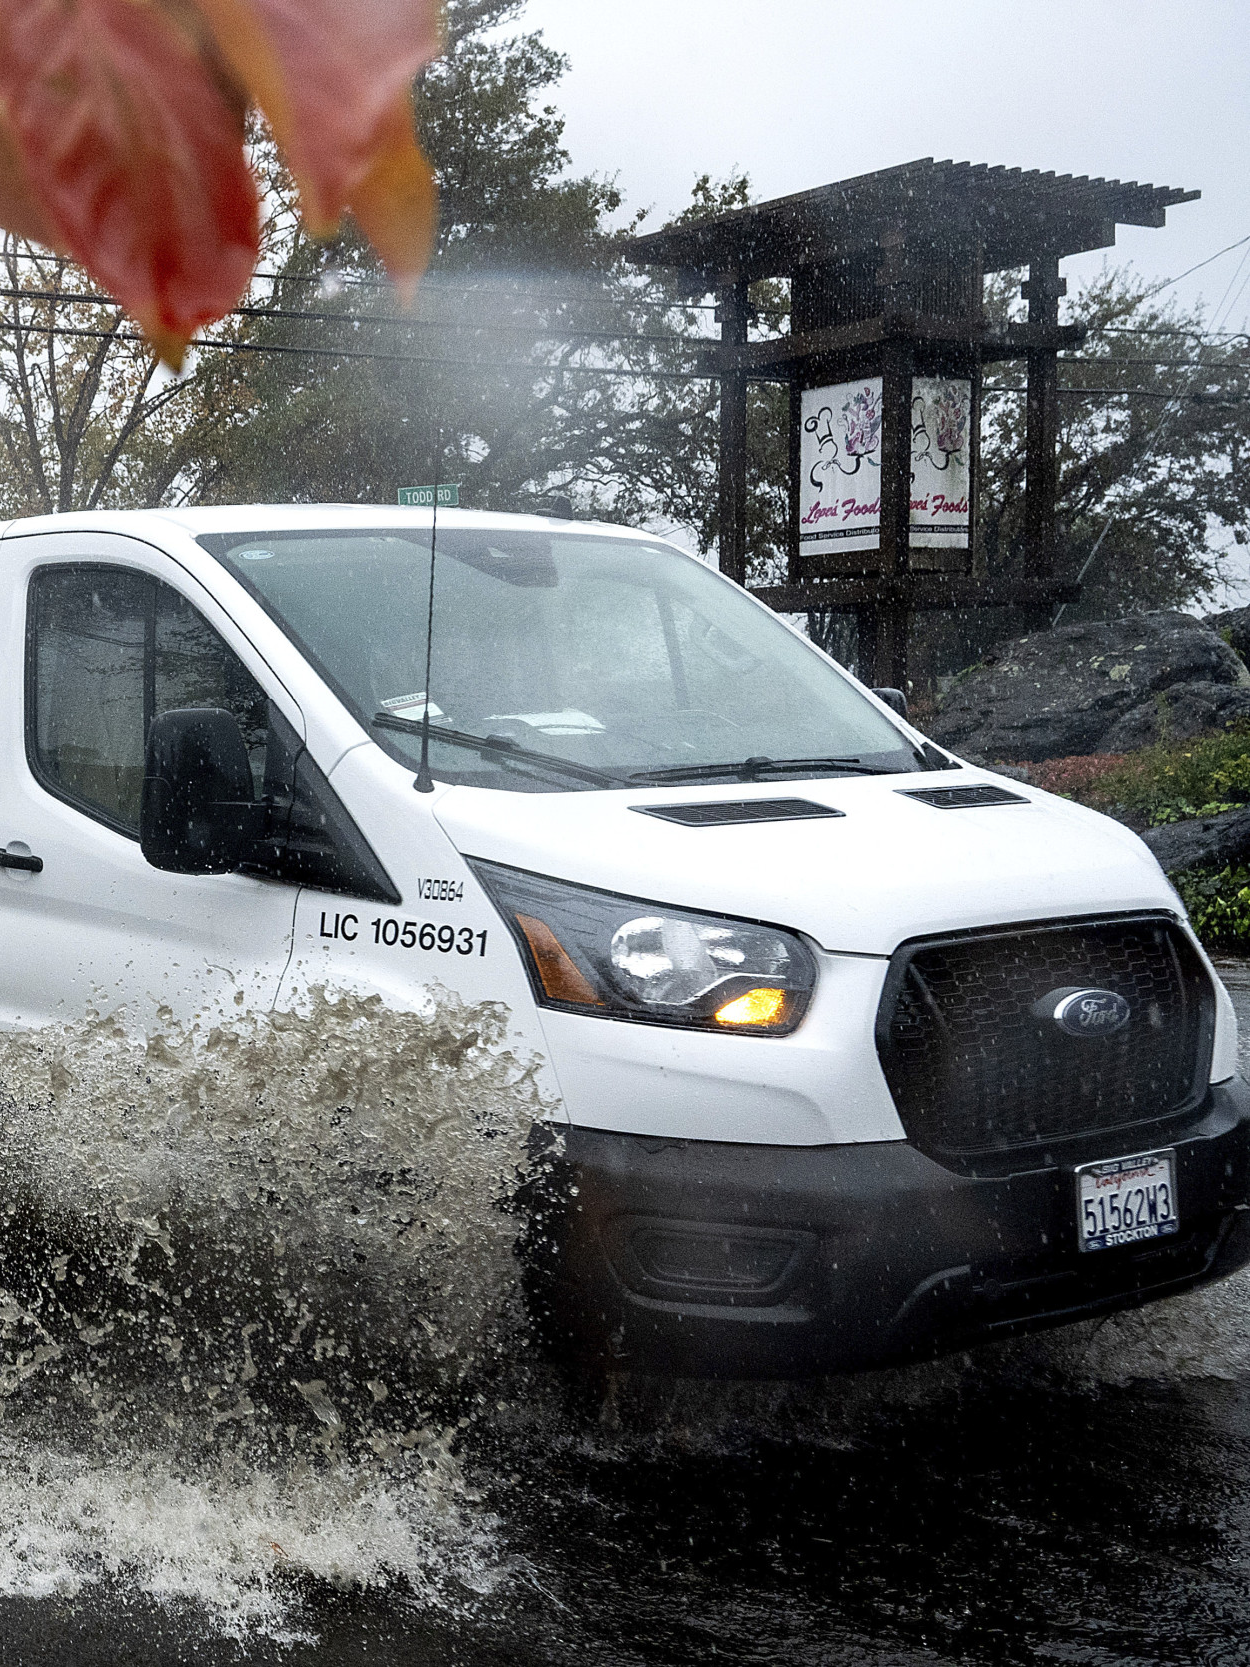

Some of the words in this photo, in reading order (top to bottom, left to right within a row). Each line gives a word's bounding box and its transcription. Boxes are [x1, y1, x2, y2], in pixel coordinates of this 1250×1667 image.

[405, 491, 433, 504] TODD
[437, 489, 451, 502] RD
[931, 494, 968, 517] Foods
[818, 531, 844, 539] Service
[845, 528, 880, 536] Distributo
[417, 877, 465, 902] V30864
[319, 911, 359, 942] LIC
[370, 917, 489, 958] 1056931
[1078, 998, 1120, 1028] Ford
[1084, 1183, 1171, 1237] 51562W3
[1105, 1223, 1159, 1246] STOCKTON
